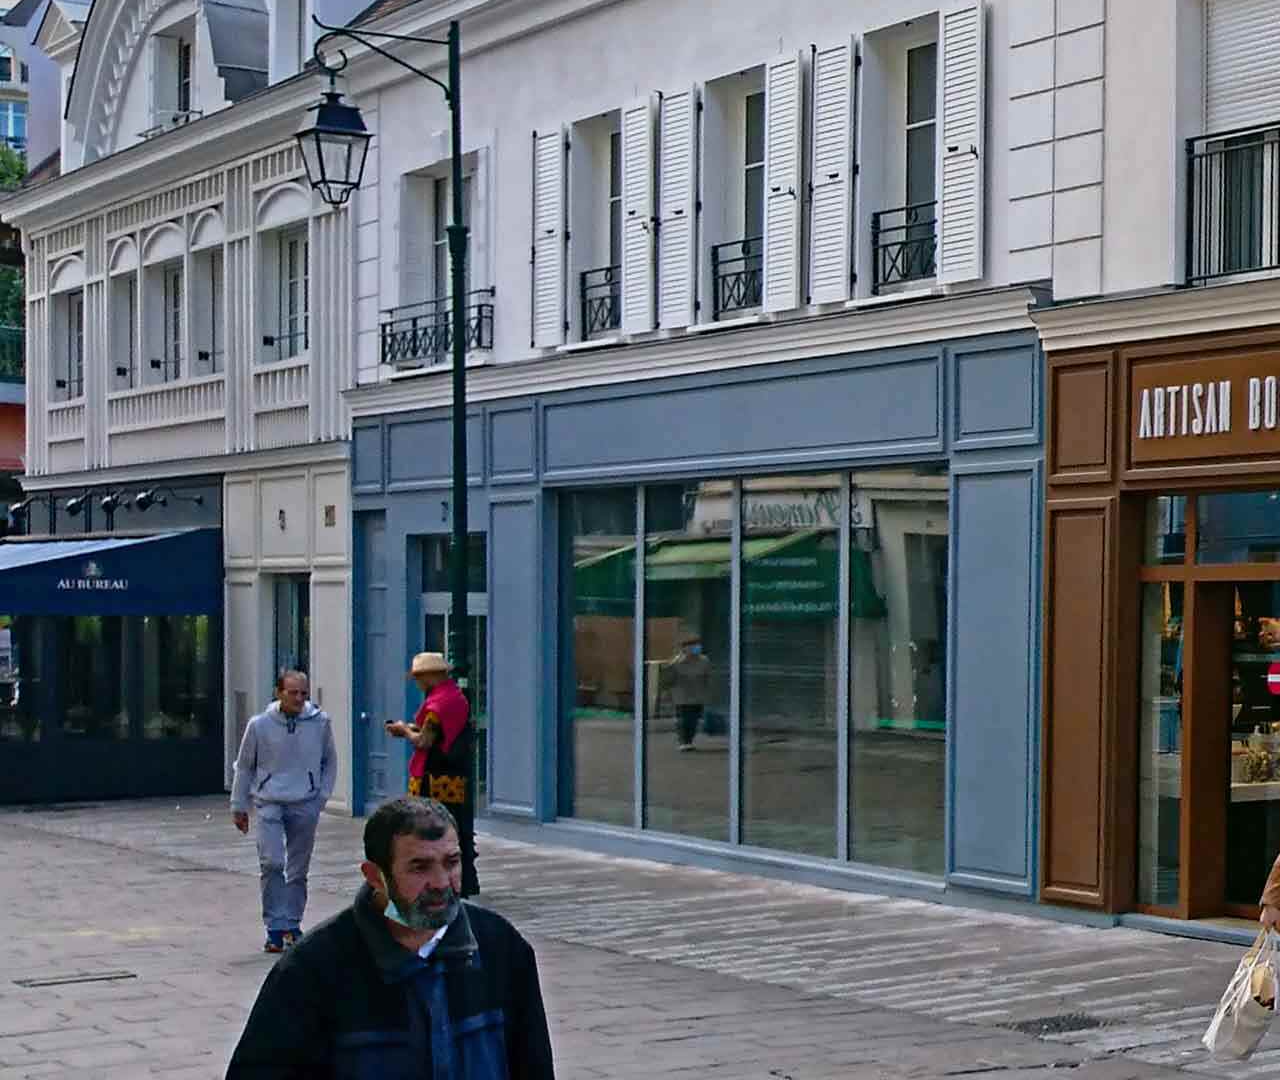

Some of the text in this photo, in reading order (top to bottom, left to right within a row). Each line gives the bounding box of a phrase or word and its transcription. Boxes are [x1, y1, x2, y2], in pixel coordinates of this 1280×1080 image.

[1138, 380, 1232, 439] ARTISAN
[57, 578, 129, 591] AU BUREAU
